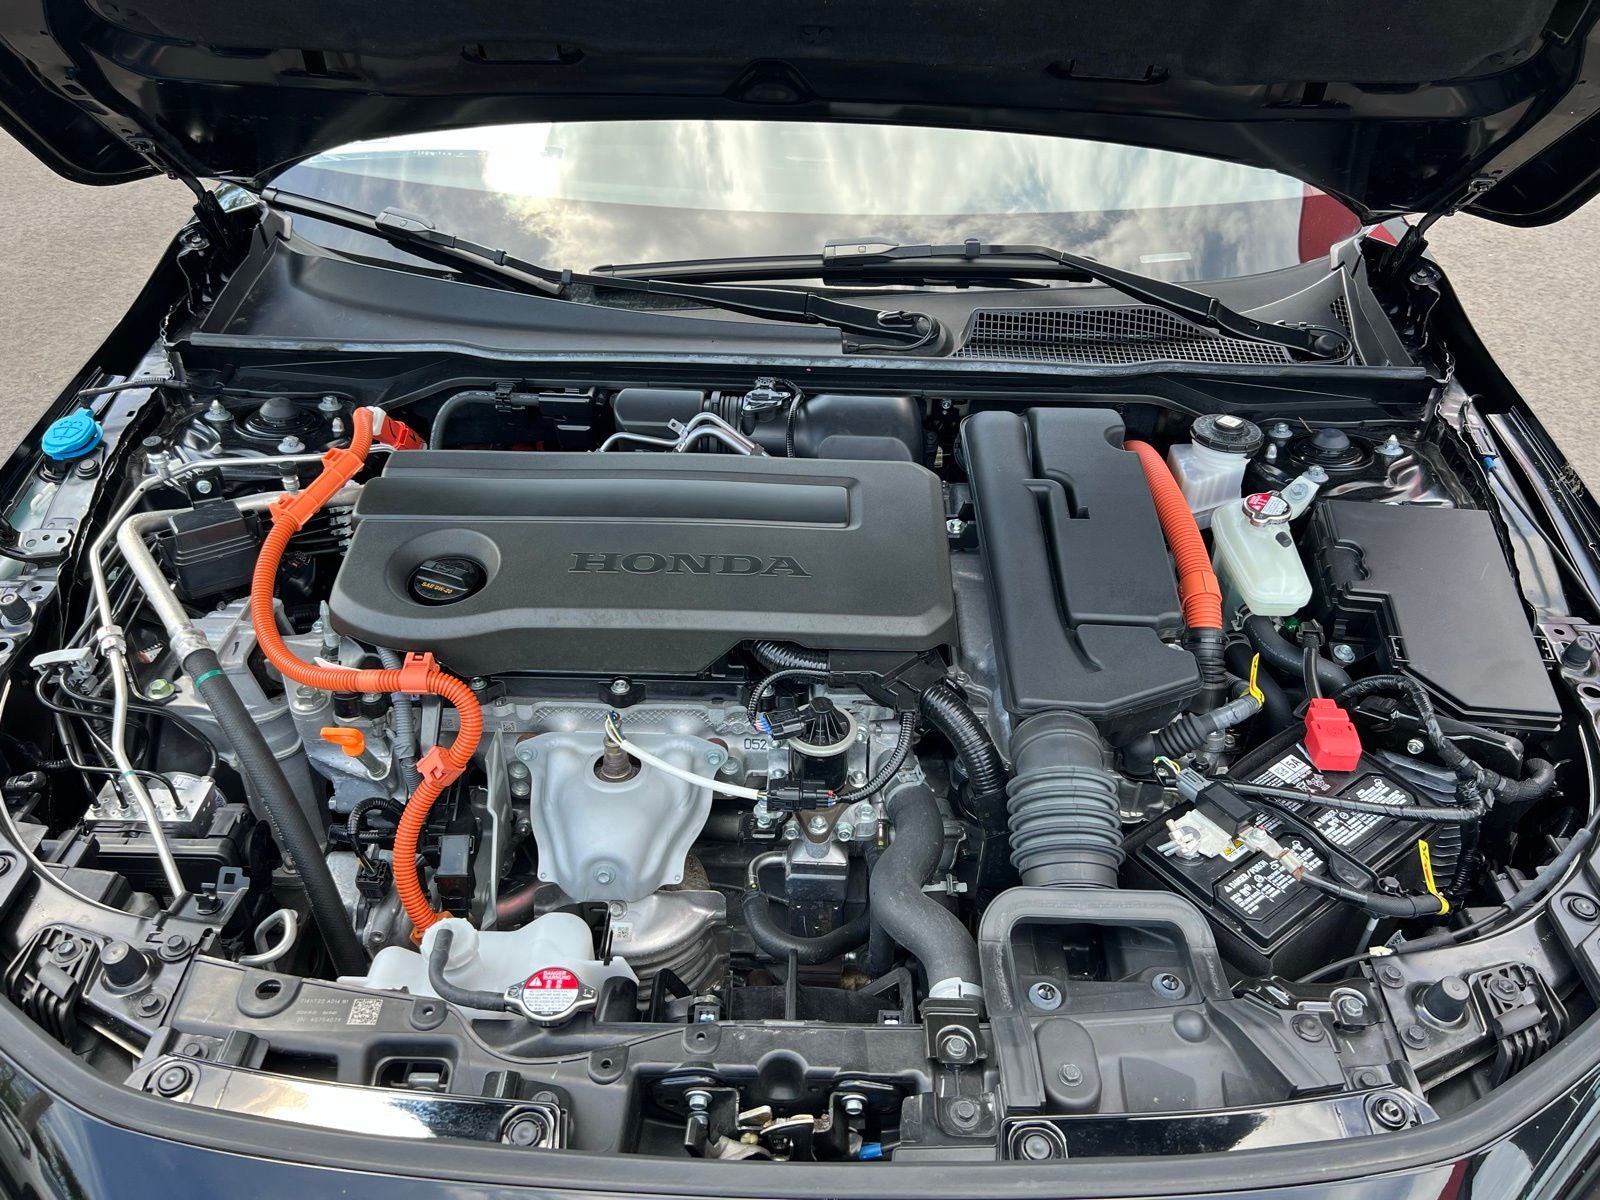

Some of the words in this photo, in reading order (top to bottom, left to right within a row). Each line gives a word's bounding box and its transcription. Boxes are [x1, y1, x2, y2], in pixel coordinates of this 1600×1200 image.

[567, 552, 813, 578] HONDA
[434, 584, 453, 594] 0W-20
[1286, 758, 1301, 769] 5A
